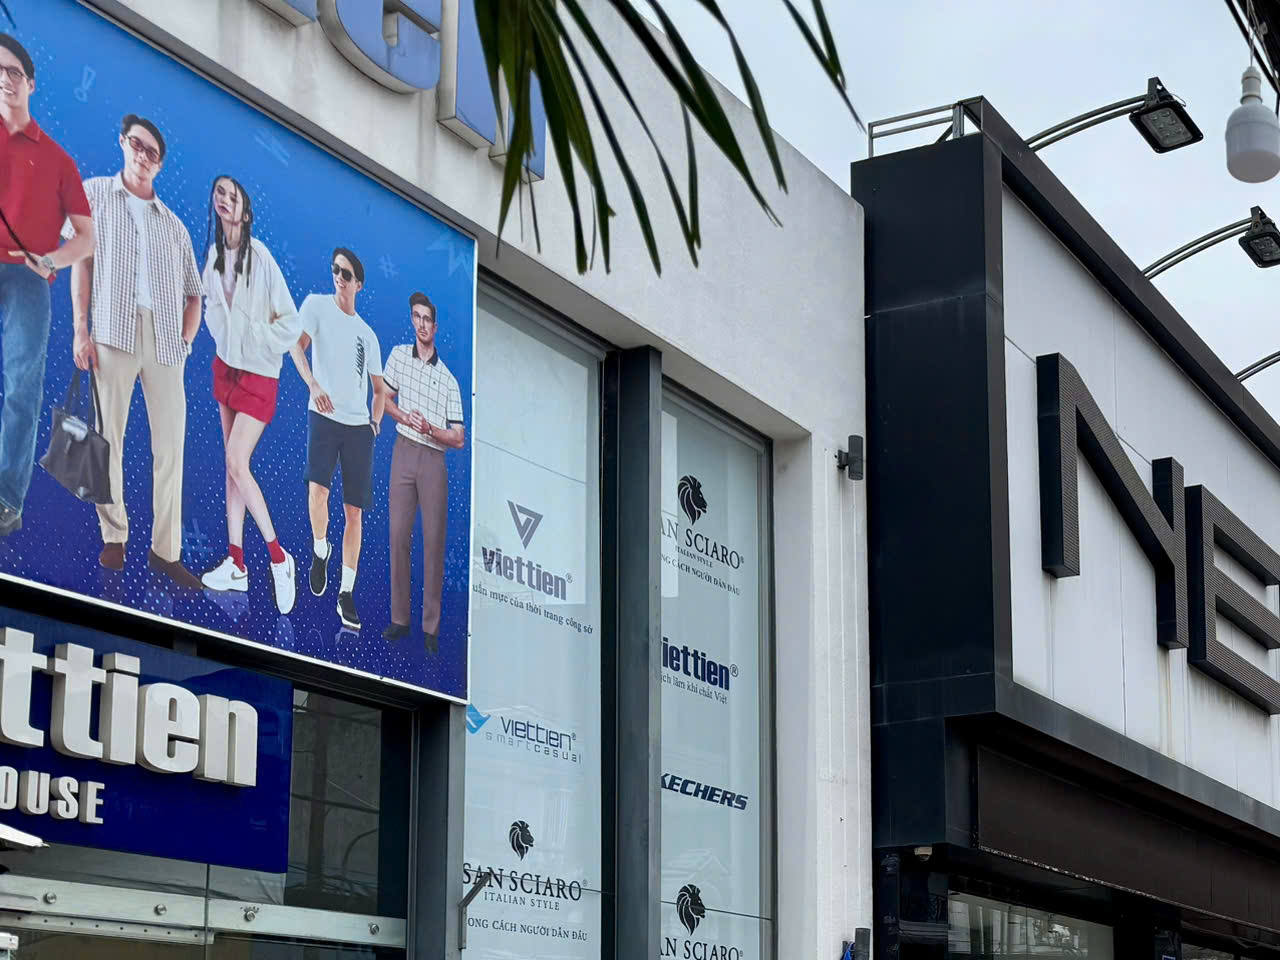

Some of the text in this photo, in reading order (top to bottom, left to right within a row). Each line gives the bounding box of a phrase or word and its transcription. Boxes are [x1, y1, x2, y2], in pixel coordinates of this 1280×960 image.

[685, 528, 740, 569] SCIARO
[482, 546, 566, 600] viettien
[544, 610, 563, 625] trang
[661, 636, 729, 691] iettien
[500, 716, 571, 751] viettien
[463, 863, 582, 901] SAN SCIARO
[484, 891, 560, 911] ITALIAN STYLE
[492, 919, 517, 932] CÁCH
[520, 924, 549, 936] NGƯỜI
